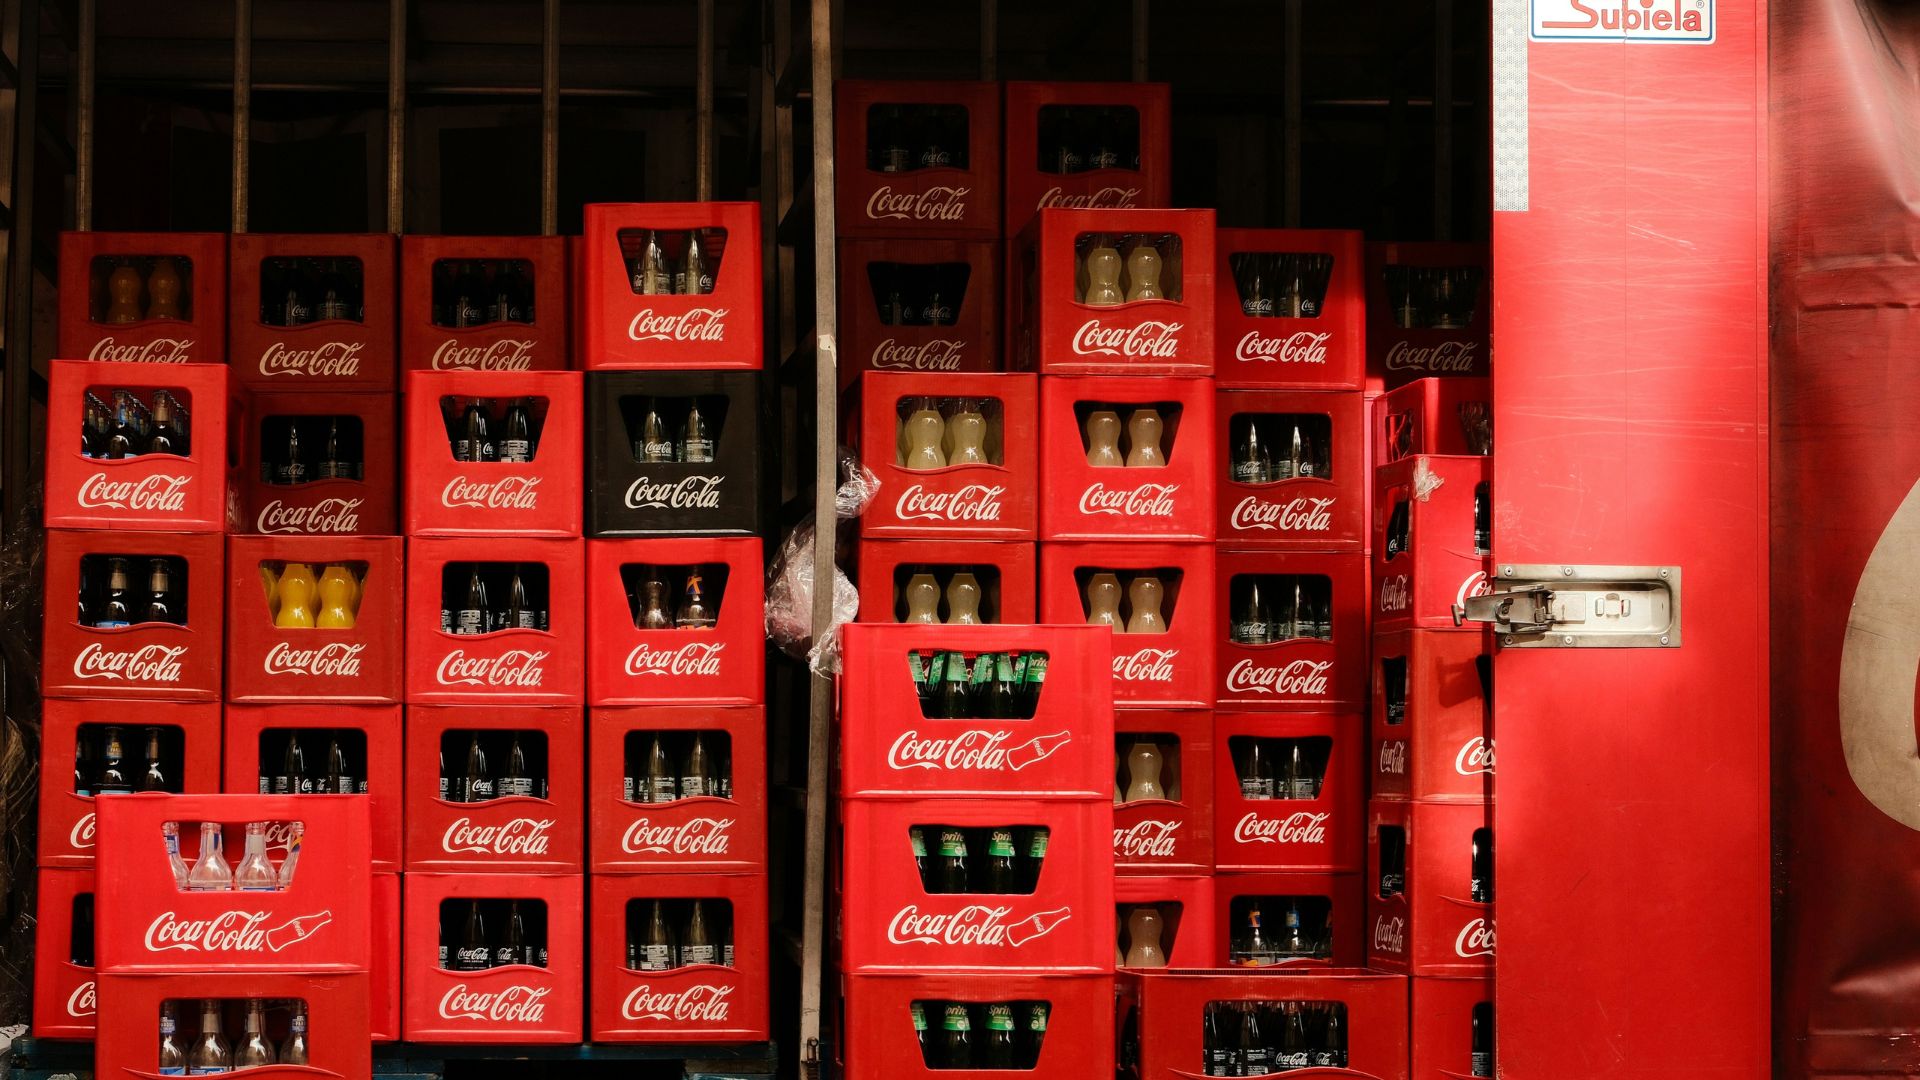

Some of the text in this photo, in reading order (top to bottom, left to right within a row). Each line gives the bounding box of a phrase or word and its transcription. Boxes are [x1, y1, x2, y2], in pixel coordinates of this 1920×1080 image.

[1542, 0, 1702, 32] Subiela
[867, 186, 970, 219] Coca-Cola
[629, 309, 728, 341] Coca-Cola
[1073, 320, 1183, 357] Coca-Cola
[260, 343, 365, 375] Coca-Cola
[431, 339, 537, 371] Coca-Cola
[871, 339, 966, 371] Coca-Cola
[1236, 331, 1331, 363] Coca-Cola
[1386, 341, 1478, 371] Coca-Cola
[78, 473, 192, 511] Coca-Cola
[442, 476, 541, 509] Coca-Cola
[625, 476, 725, 508] Coca-Cola
[896, 485, 1005, 520] Coca-Cola
[1079, 483, 1179, 516] Coca-Cola
[257, 499, 365, 536] Coca-Cola
[1231, 496, 1336, 531] Coca-Cola
[74, 643, 187, 681] Coca-Cola
[265, 642, 366, 676] Coca-Cola
[437, 650, 549, 686] Coca-Cola
[625, 643, 724, 675] Coca-Cola
[1113, 649, 1178, 681] a-Cola
[1227, 659, 1333, 694] Coca-Cola
[888, 731, 1012, 771] Coca-Cola
[443, 818, 555, 854] Coca-Cola
[622, 818, 735, 854] Coca-Cola
[1114, 821, 1181, 856] a-Cola
[1234, 812, 1330, 843] Coca-Cola
[145, 911, 272, 951] Coca-Cola
[888, 905, 1012, 946] Coca-Cola
[439, 985, 551, 1022] Coca-Cola
[622, 985, 734, 1020] Coca-Cola
